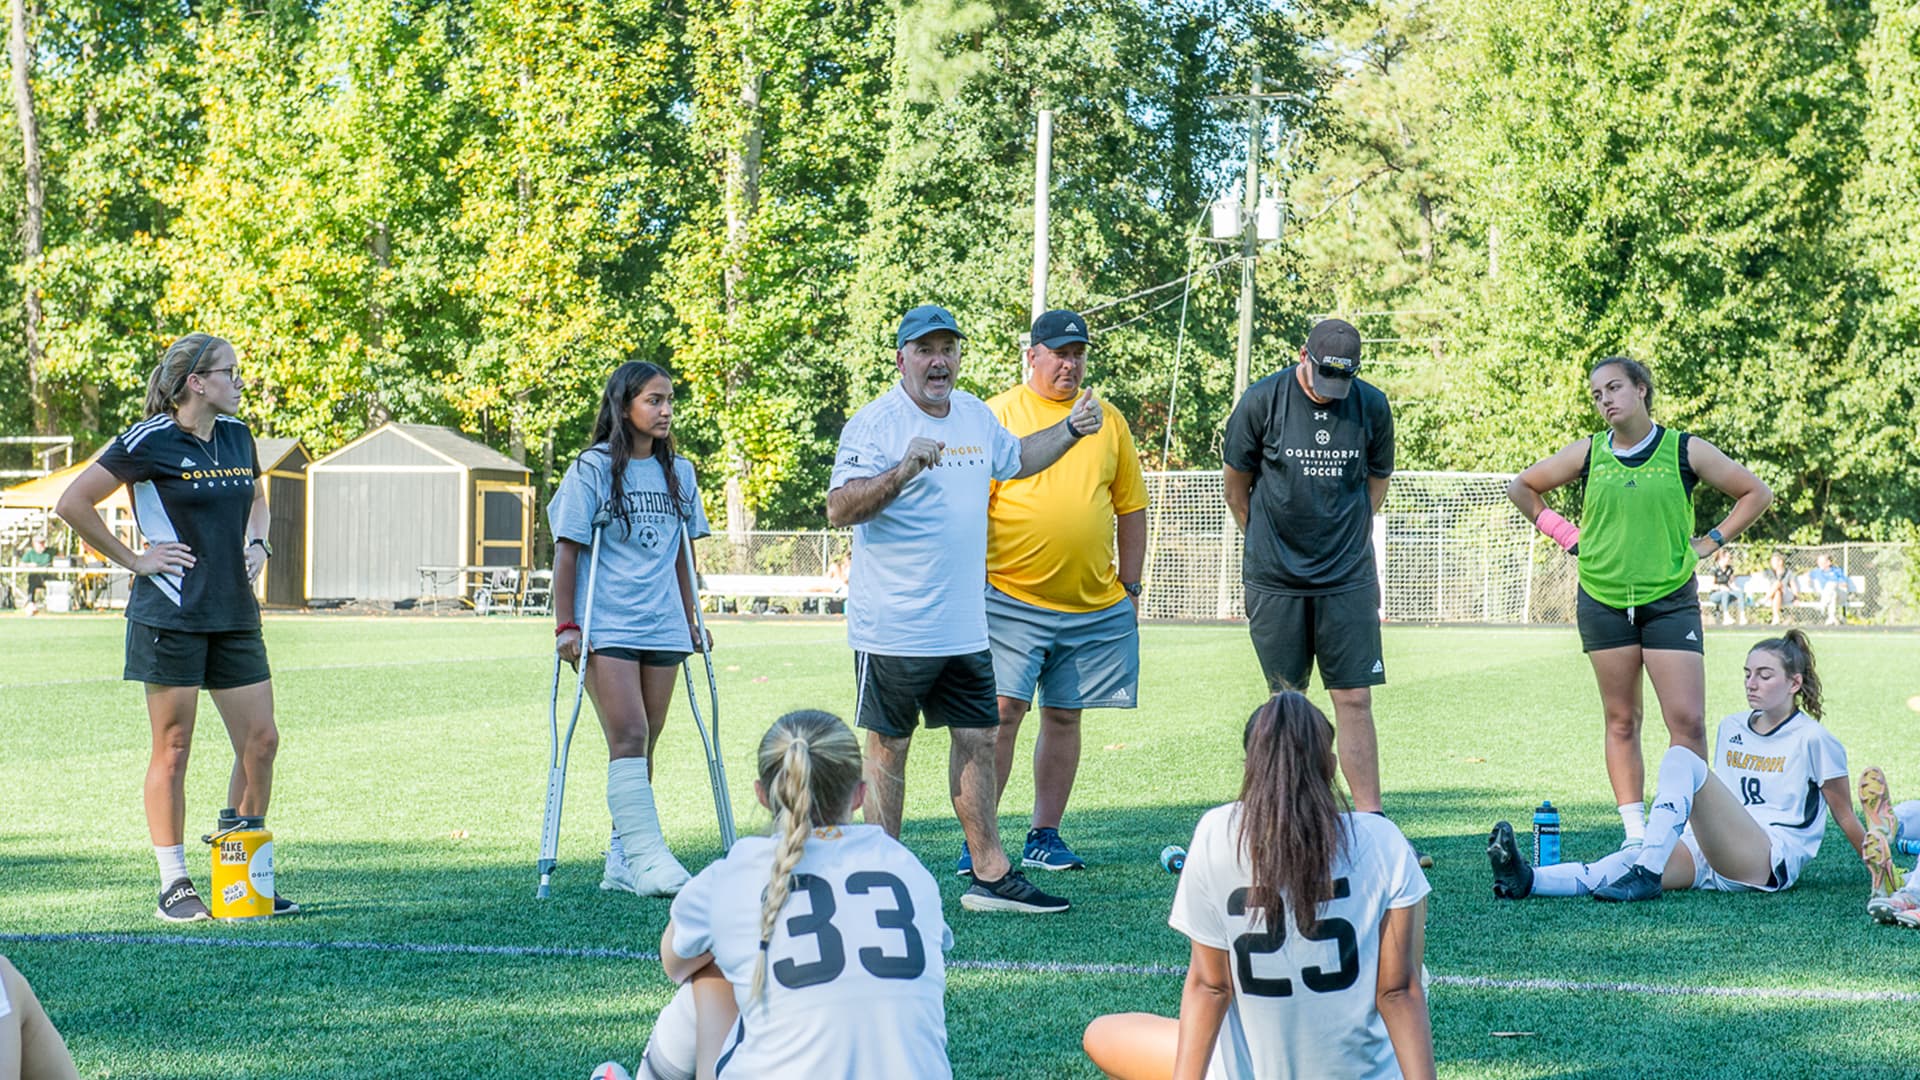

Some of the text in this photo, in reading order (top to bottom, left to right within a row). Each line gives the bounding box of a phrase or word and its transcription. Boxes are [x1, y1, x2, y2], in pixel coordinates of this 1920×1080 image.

[1285, 448, 1360, 459] OGLETHORPE
[1303, 467, 1343, 477] SOCCER
[631, 515, 666, 525] SOCCER
[1740, 776, 1766, 806] 18
[761, 871, 926, 989] 33
[1227, 876, 1360, 997] 25
